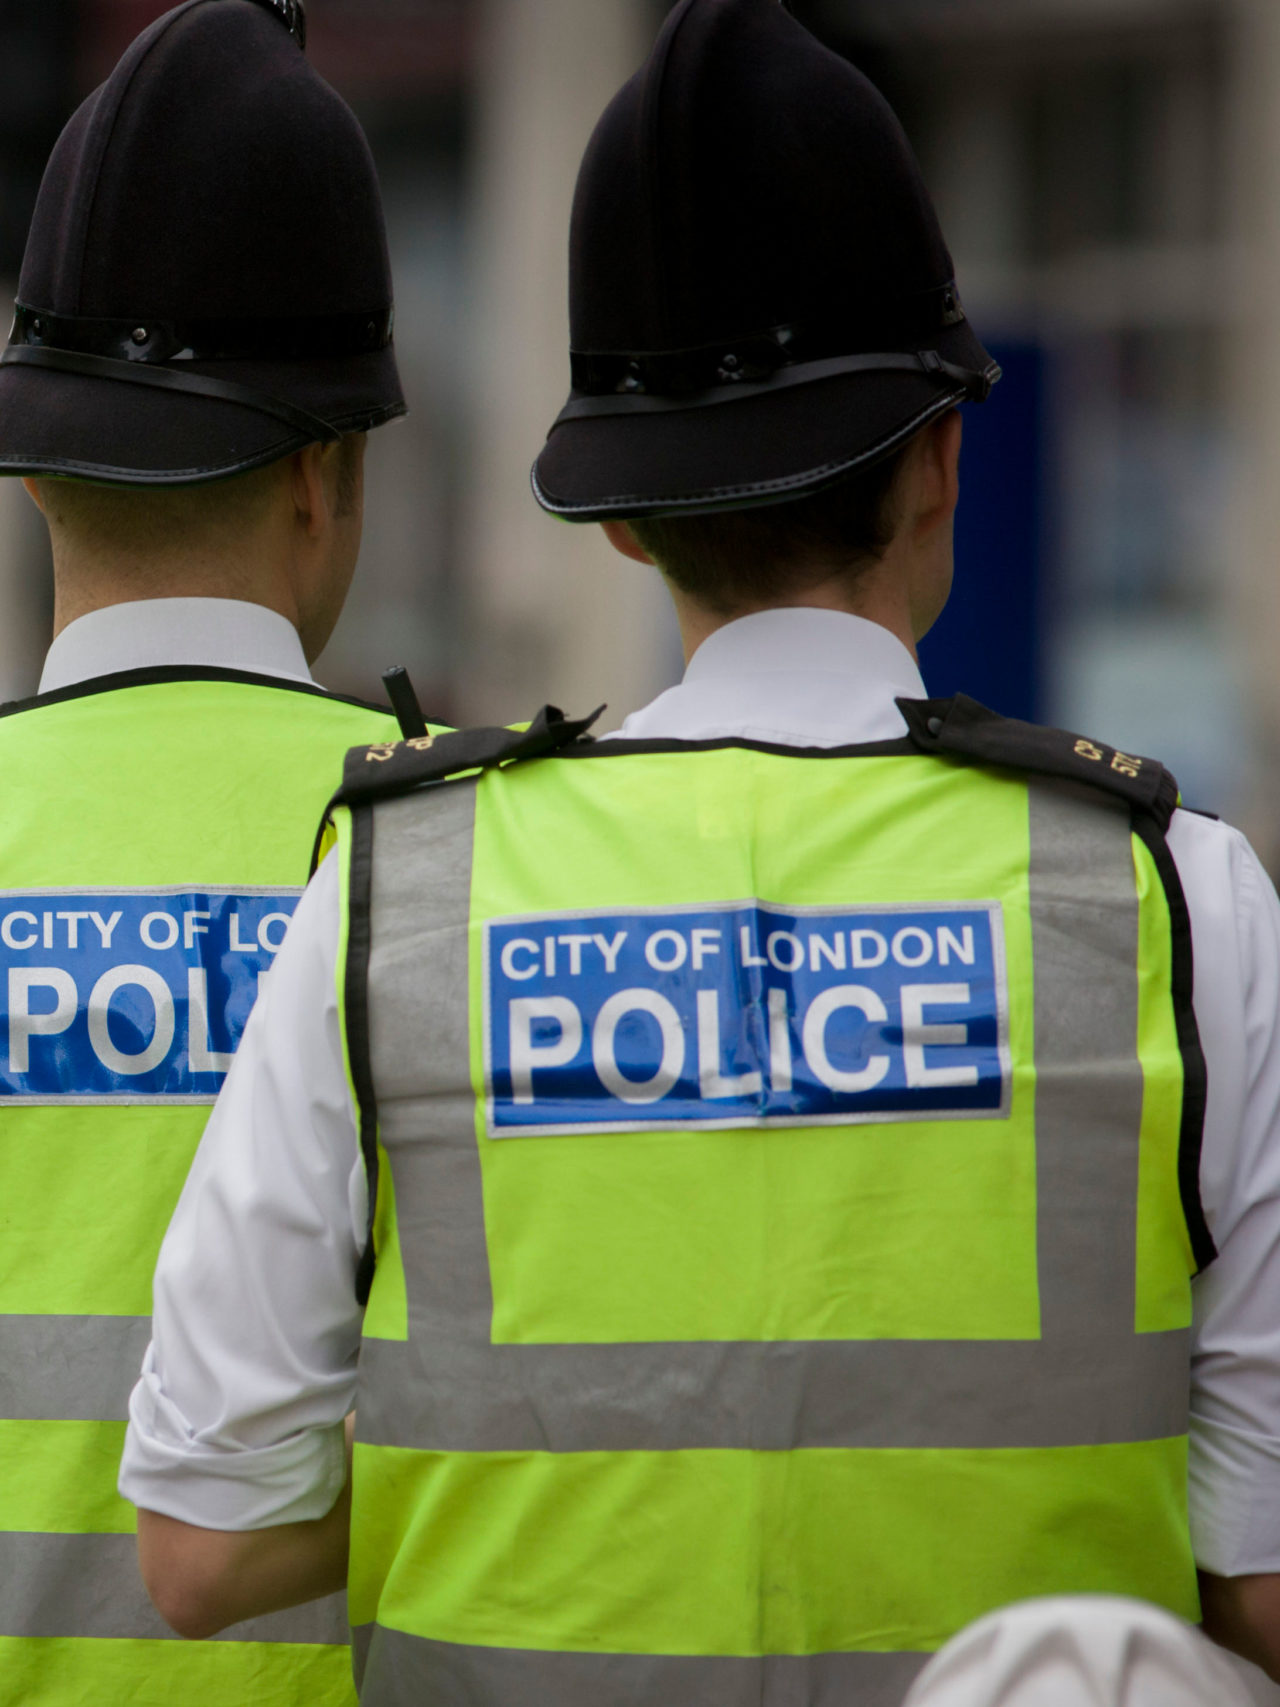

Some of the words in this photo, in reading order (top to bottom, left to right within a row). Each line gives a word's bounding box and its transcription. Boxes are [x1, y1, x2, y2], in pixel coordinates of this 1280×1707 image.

[1, 911, 123, 950] CITY
[139, 911, 211, 950] OF
[501, 932, 627, 980] CITY
[644, 929, 721, 972] OF
[739, 925, 976, 972] LONDON
[509, 983, 978, 1105] POLICE
